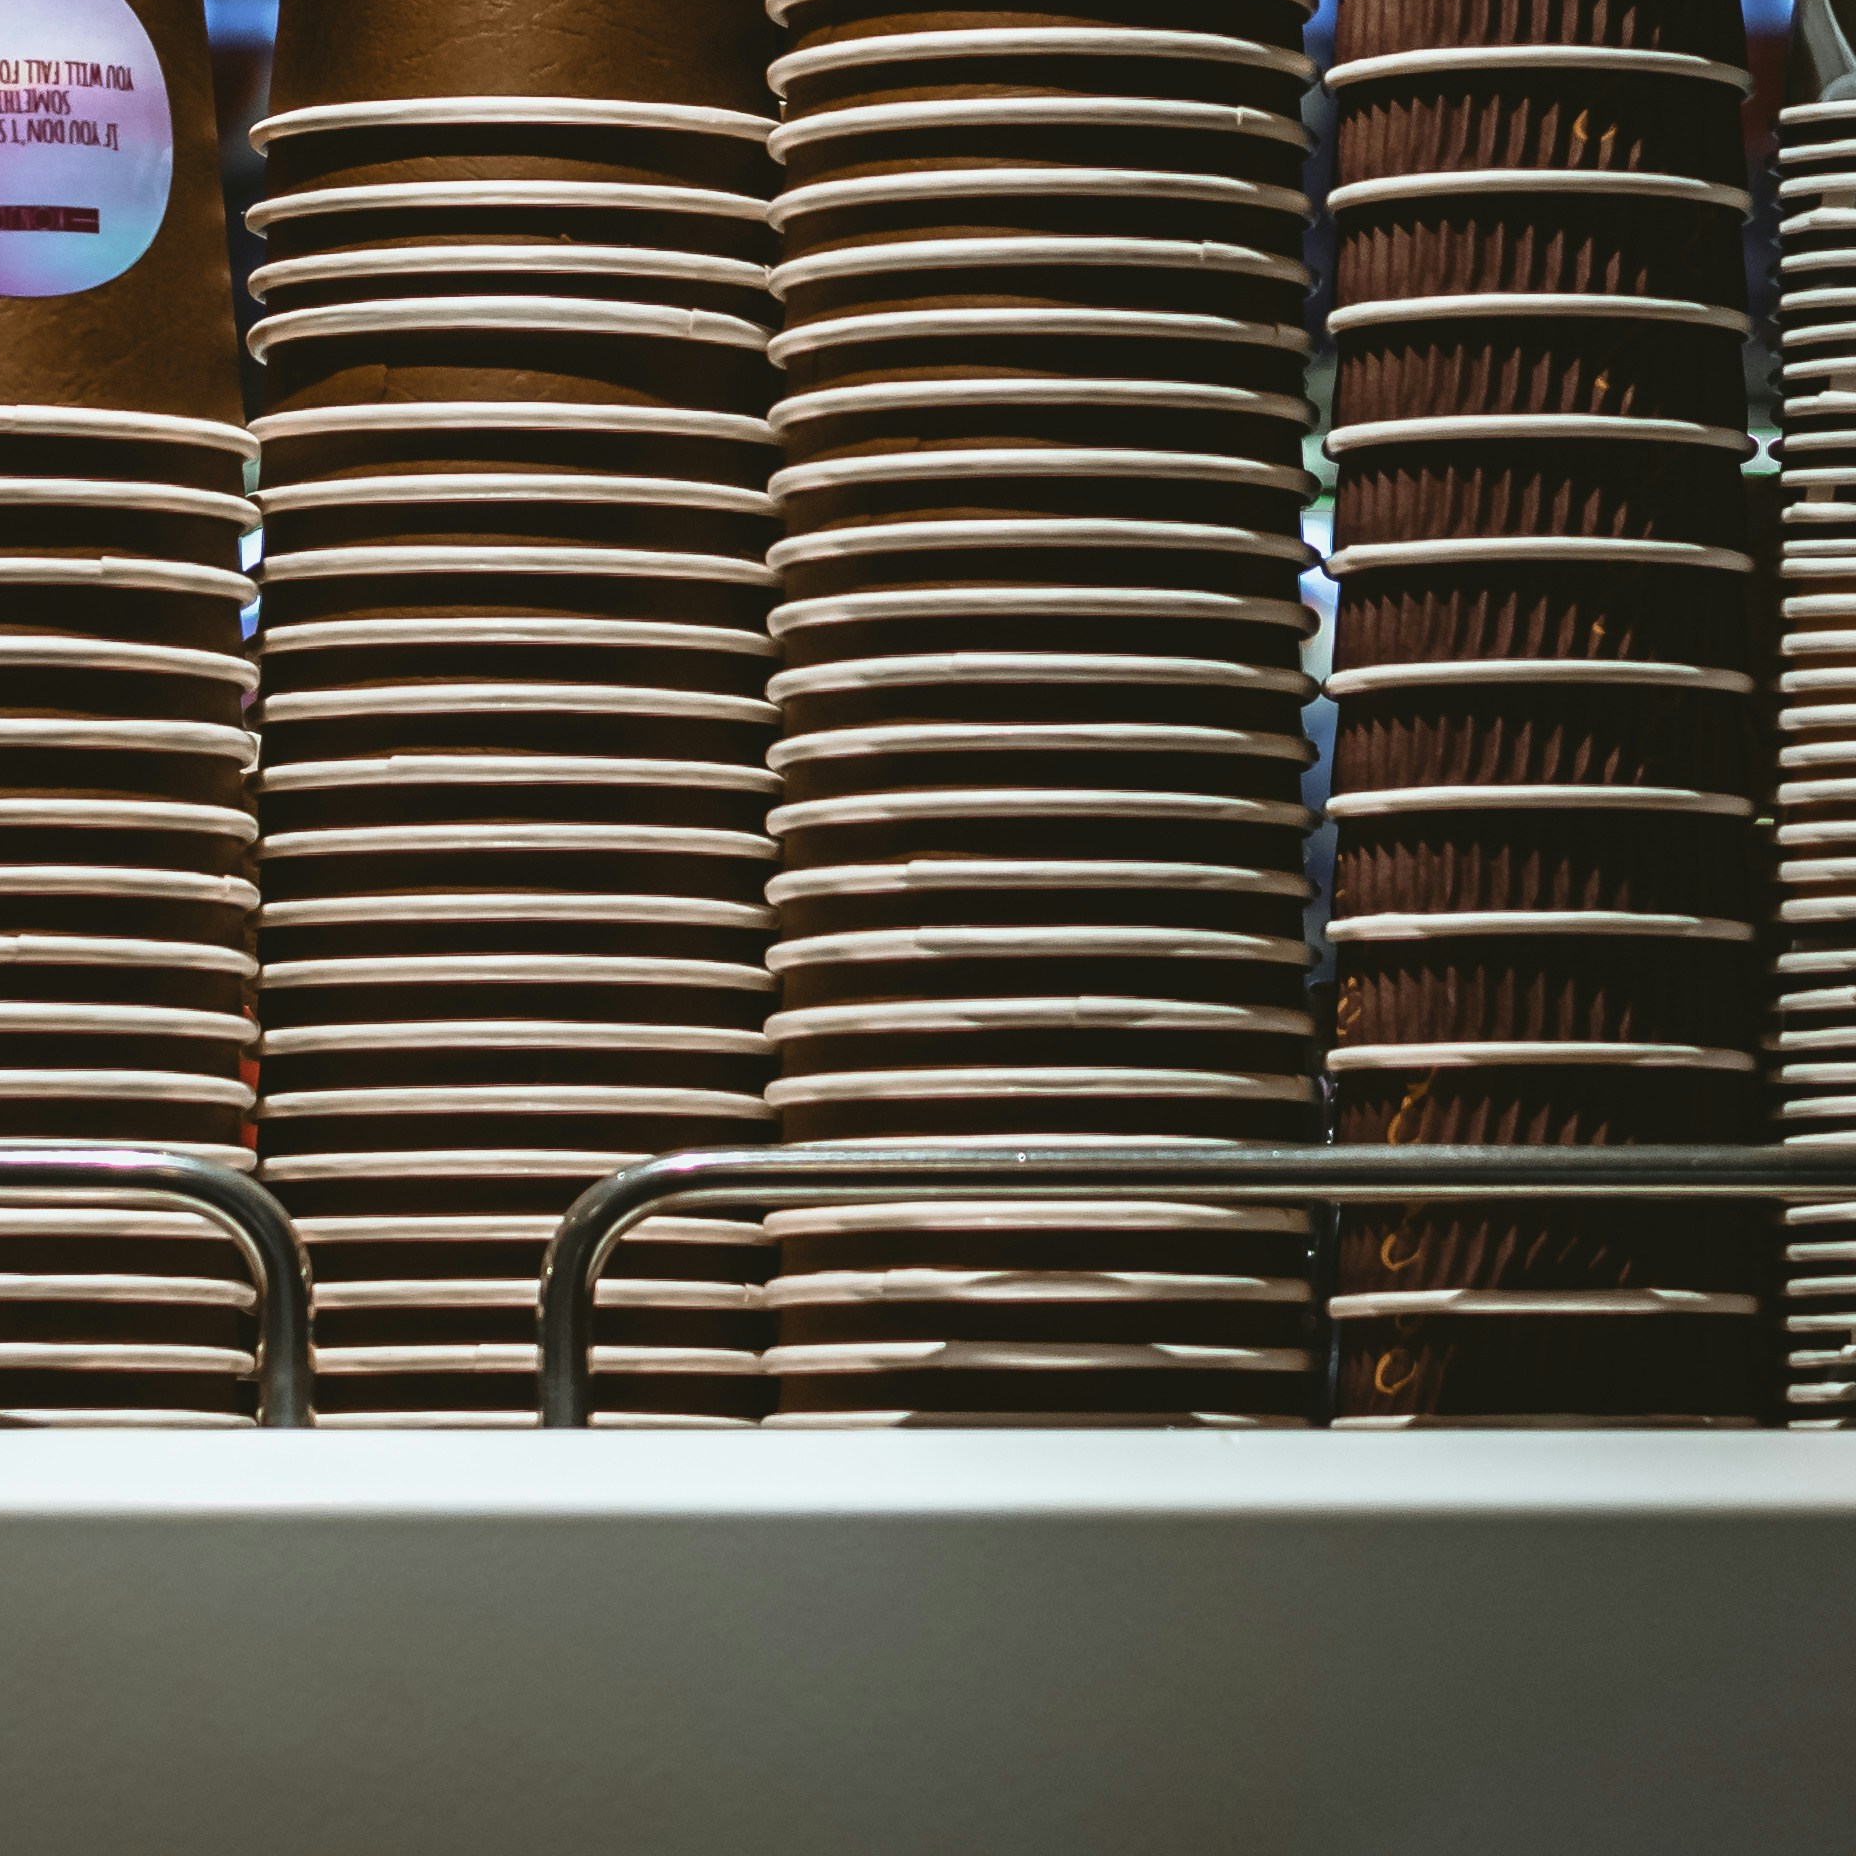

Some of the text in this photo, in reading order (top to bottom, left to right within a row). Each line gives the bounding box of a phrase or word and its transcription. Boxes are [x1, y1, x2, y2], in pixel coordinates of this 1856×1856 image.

[23, 59, 60, 86] FALL
[64, 60, 104, 89] WILL
[105, 64, 135, 92] YOU
[10, 118, 65, 146] DON'T
[68, 119, 100, 145] YOU
[103, 122, 119, 151] IF
